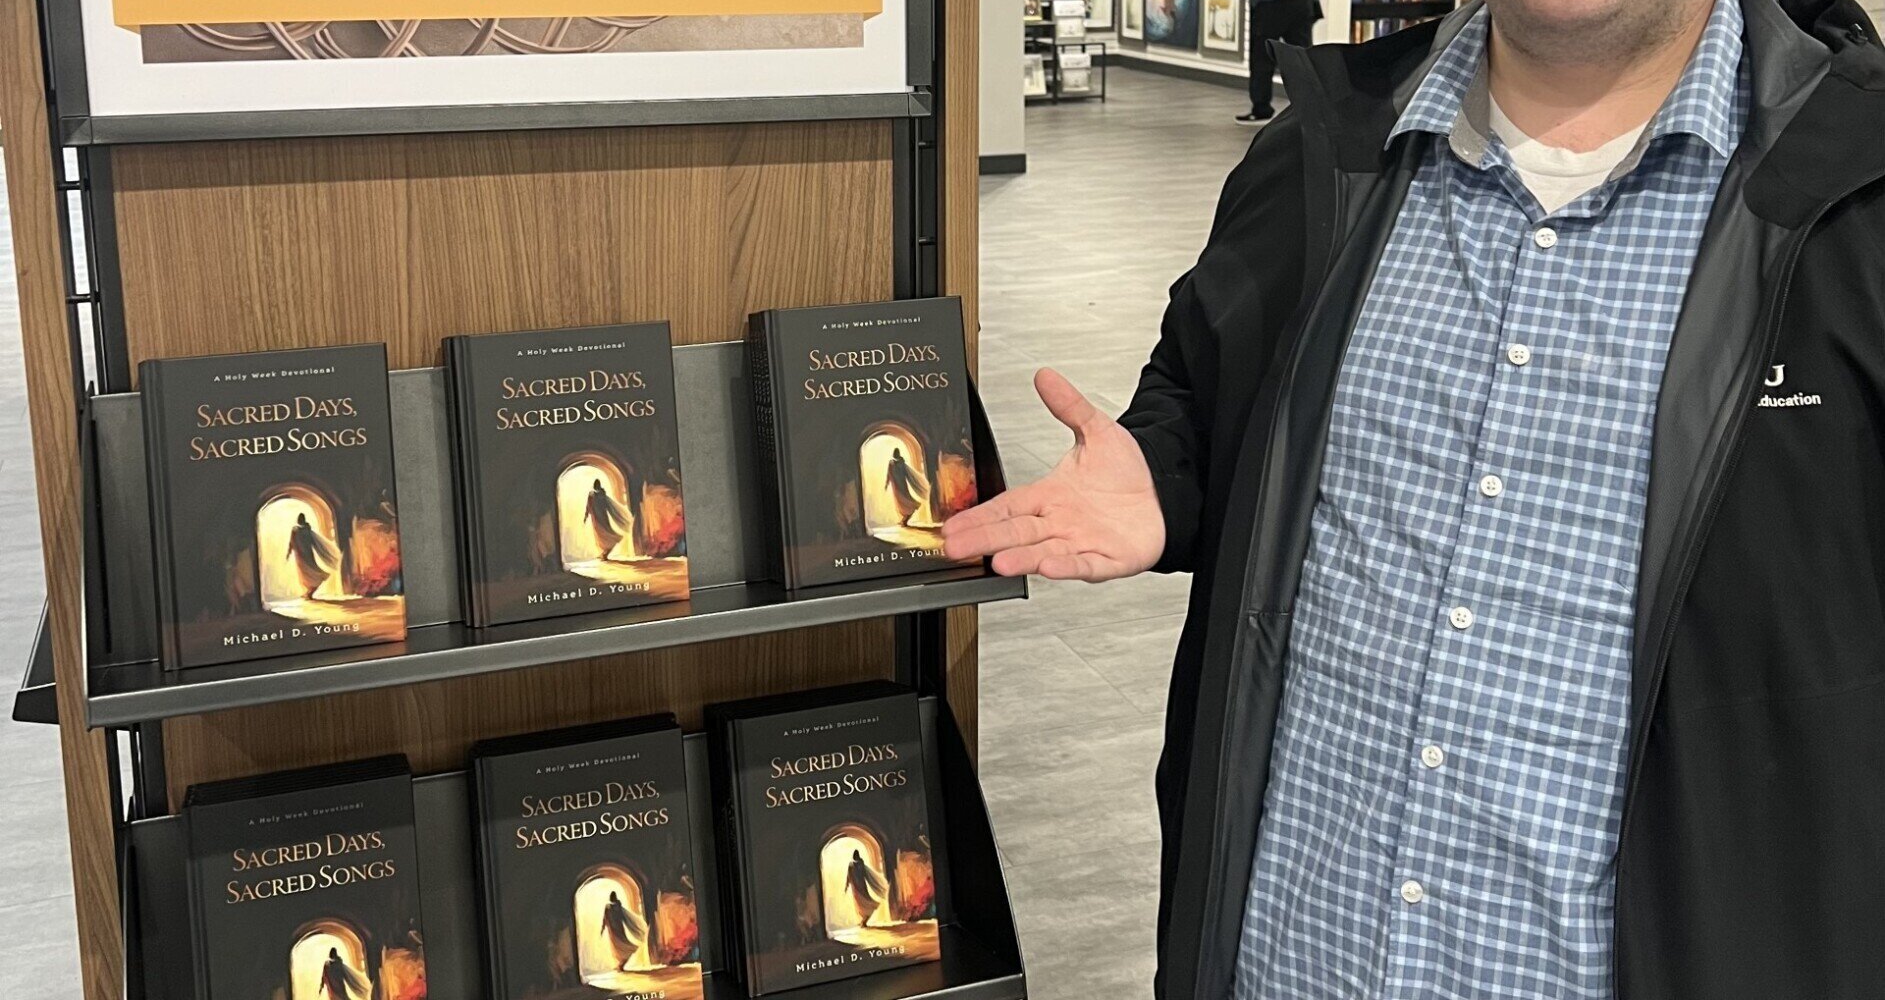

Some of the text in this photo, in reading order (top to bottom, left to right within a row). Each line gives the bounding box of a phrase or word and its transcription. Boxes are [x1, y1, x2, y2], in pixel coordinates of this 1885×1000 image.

[831, 321, 849, 330] Holy
[853, 319, 874, 327] Week
[877, 316, 921, 326] Devotional
[527, 348, 547, 356] Holy
[551, 345, 574, 354] Week
[577, 342, 626, 352] Devotional
[809, 343, 940, 371] SACRED DAYS,
[225, 372, 247, 382] Holy
[251, 370, 276, 379] Week
[281, 366, 335, 377] Devotional
[502, 370, 646, 400] SACRED DAYS,
[804, 371, 949, 400] SACRED SONGS
[197, 396, 358, 428] SACRED DAYS,
[1757, 392, 1821, 407] ducation
[496, 399, 656, 431] SACRED SONGS
[190, 427, 367, 461] SACRED SONGS
[834, 552, 884, 568] Michael
[891, 551, 903, 560] D.
[527, 581, 650, 604] Michael D. Young
[224, 622, 360, 646] Michael D. Young
[792, 727, 810, 736] Holy
[813, 724, 834, 732] Week
[837, 716, 879, 728] Devotional
[545, 765, 565, 773] Holy
[569, 761, 590, 769] Week
[594, 753, 640, 765] Devotional
[771, 743, 898, 779] SACRED DAYS,
[522, 780, 660, 818] SACRED DAYS,
[766, 769, 907, 809] SACRED SONGS
[516, 807, 669, 850] SACRED SONGS
[233, 831, 386, 872] SACRED DAYS,
[226, 859, 396, 904] SACRED SONGS
[796, 945, 905, 973] Michael D. Young
